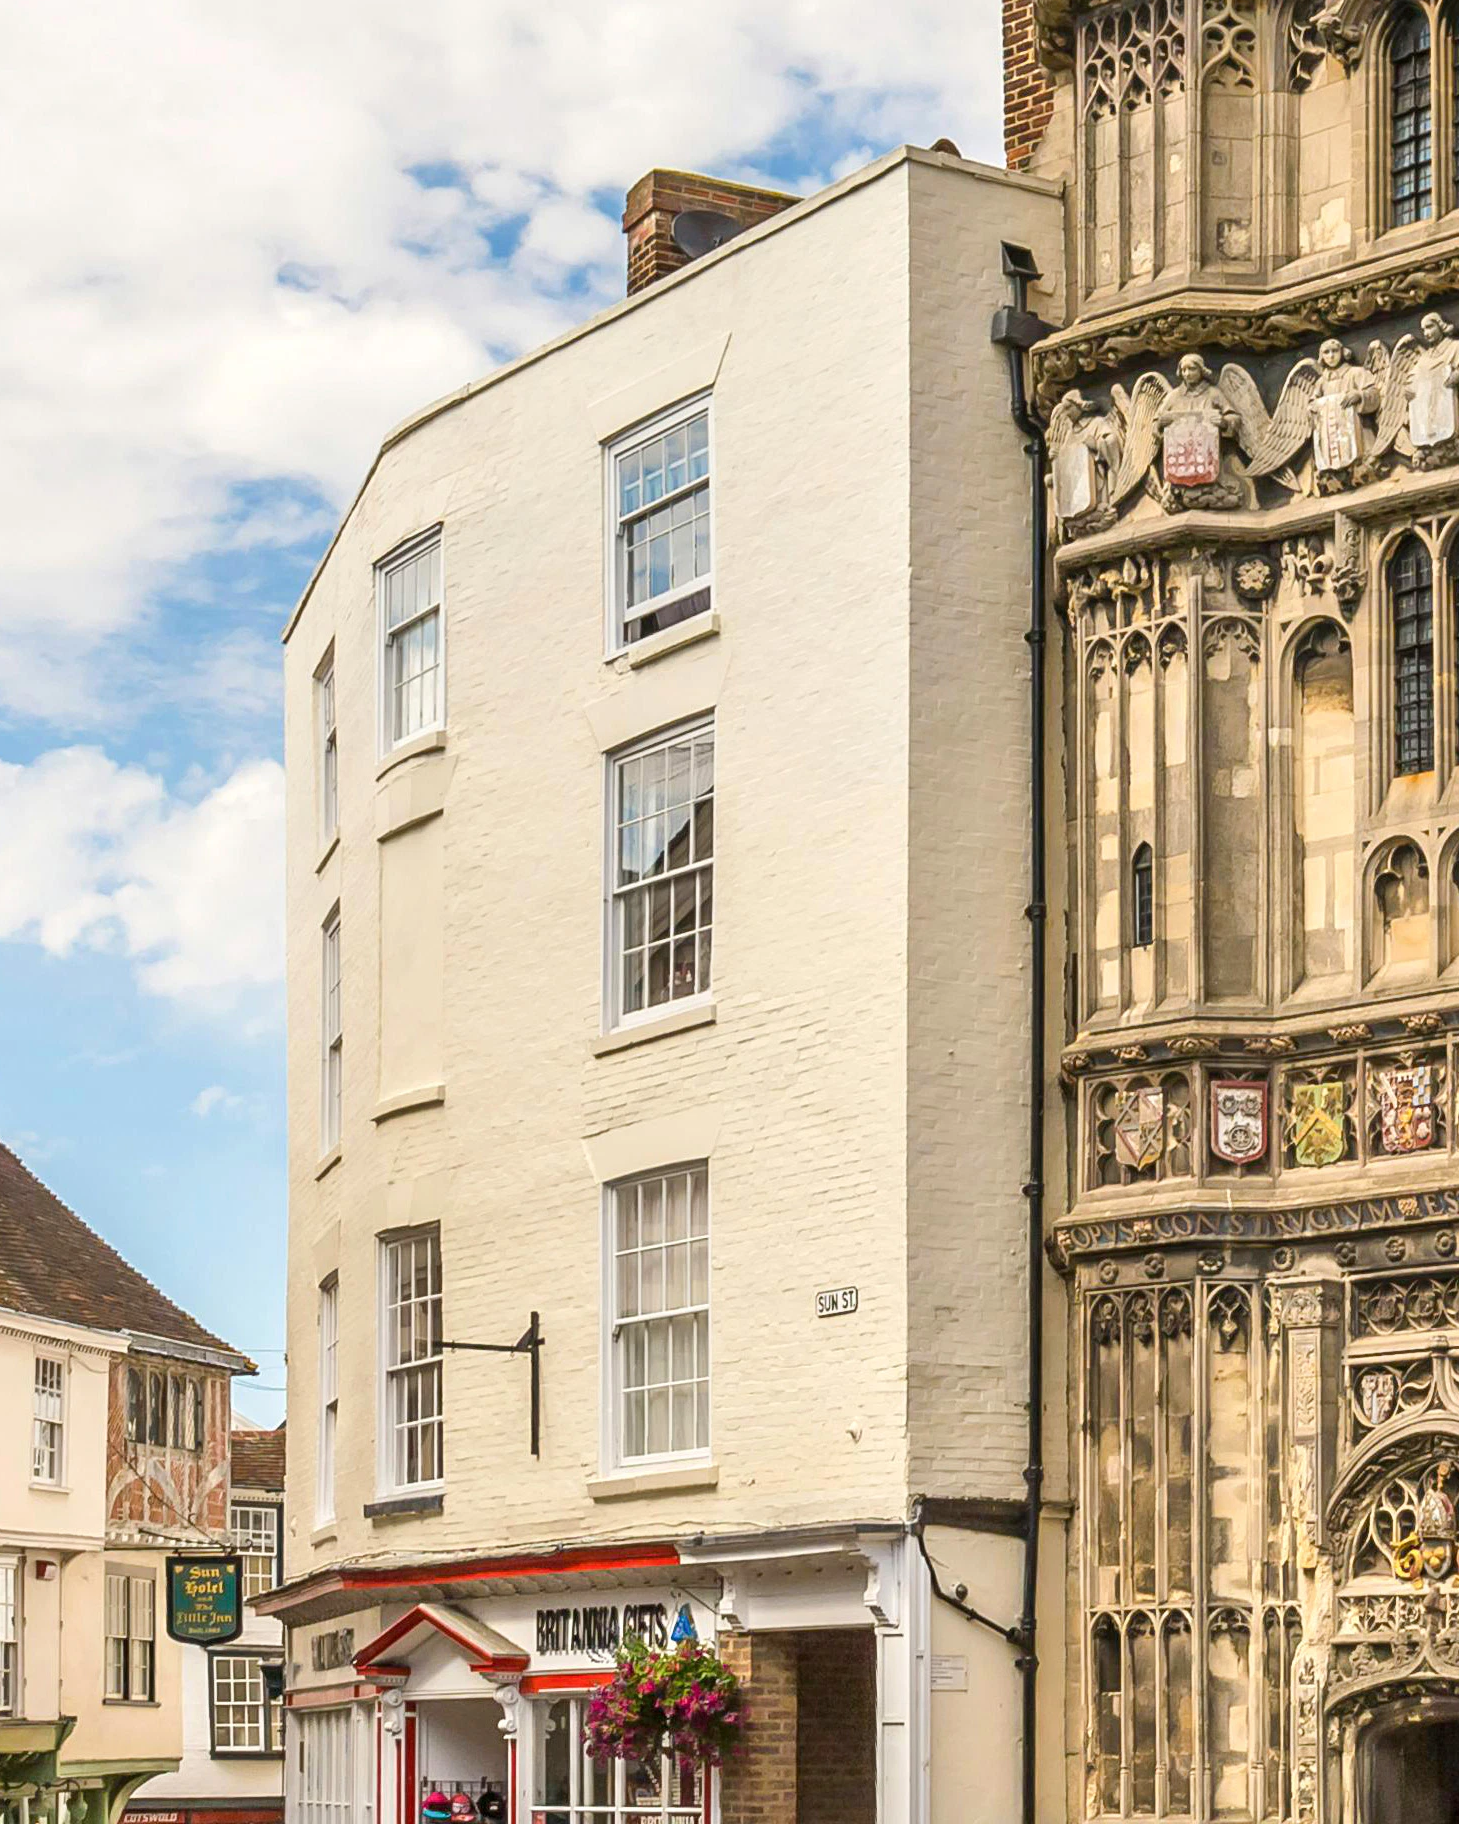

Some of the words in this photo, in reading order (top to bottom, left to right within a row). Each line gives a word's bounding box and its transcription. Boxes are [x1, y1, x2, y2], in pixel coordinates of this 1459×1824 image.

[818, 1293, 838, 1313] SUN
[189, 1566, 220, 1579] Sun
[184, 1580, 224, 1597] Hotel
[536, 1607, 619, 1652] BRITANNIA
[622, 1603, 668, 1650] GIFTS
